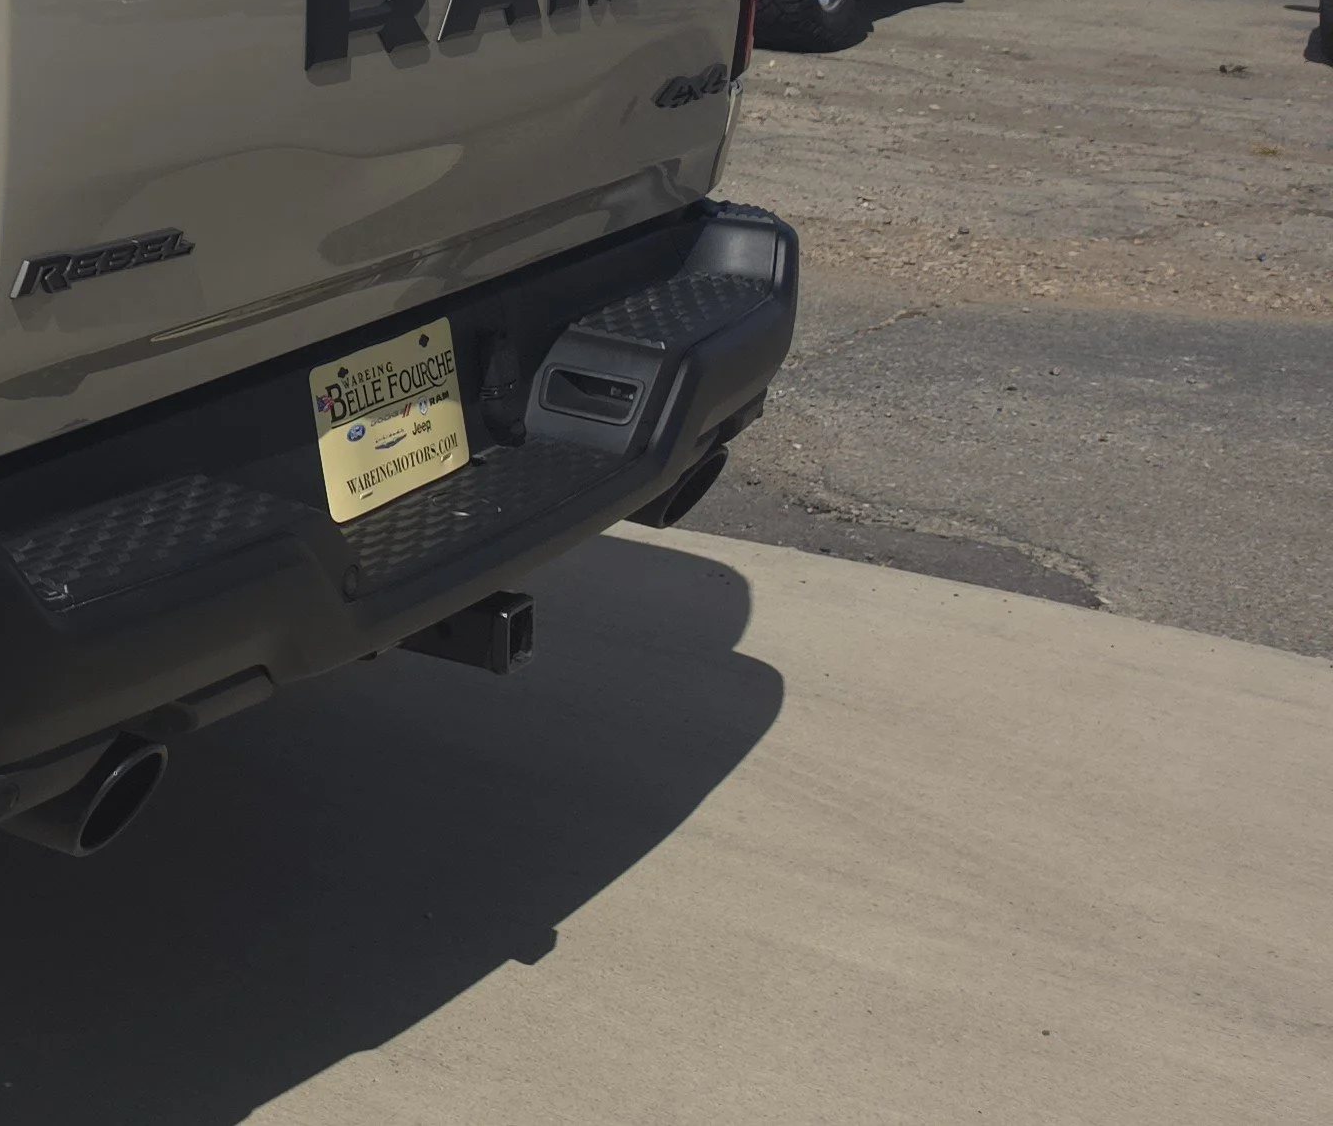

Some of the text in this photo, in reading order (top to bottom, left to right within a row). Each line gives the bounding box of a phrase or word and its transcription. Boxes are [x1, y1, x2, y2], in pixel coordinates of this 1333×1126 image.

[9, 227, 196, 299] REBEL
[325, 350, 455, 423] BELLE FOURCHE
[341, 361, 394, 389] WAREING
[429, 390, 450, 407] RAM
[412, 420, 432, 436] Jeep
[346, 432, 458, 496] WAREINGMOTORS.COM
